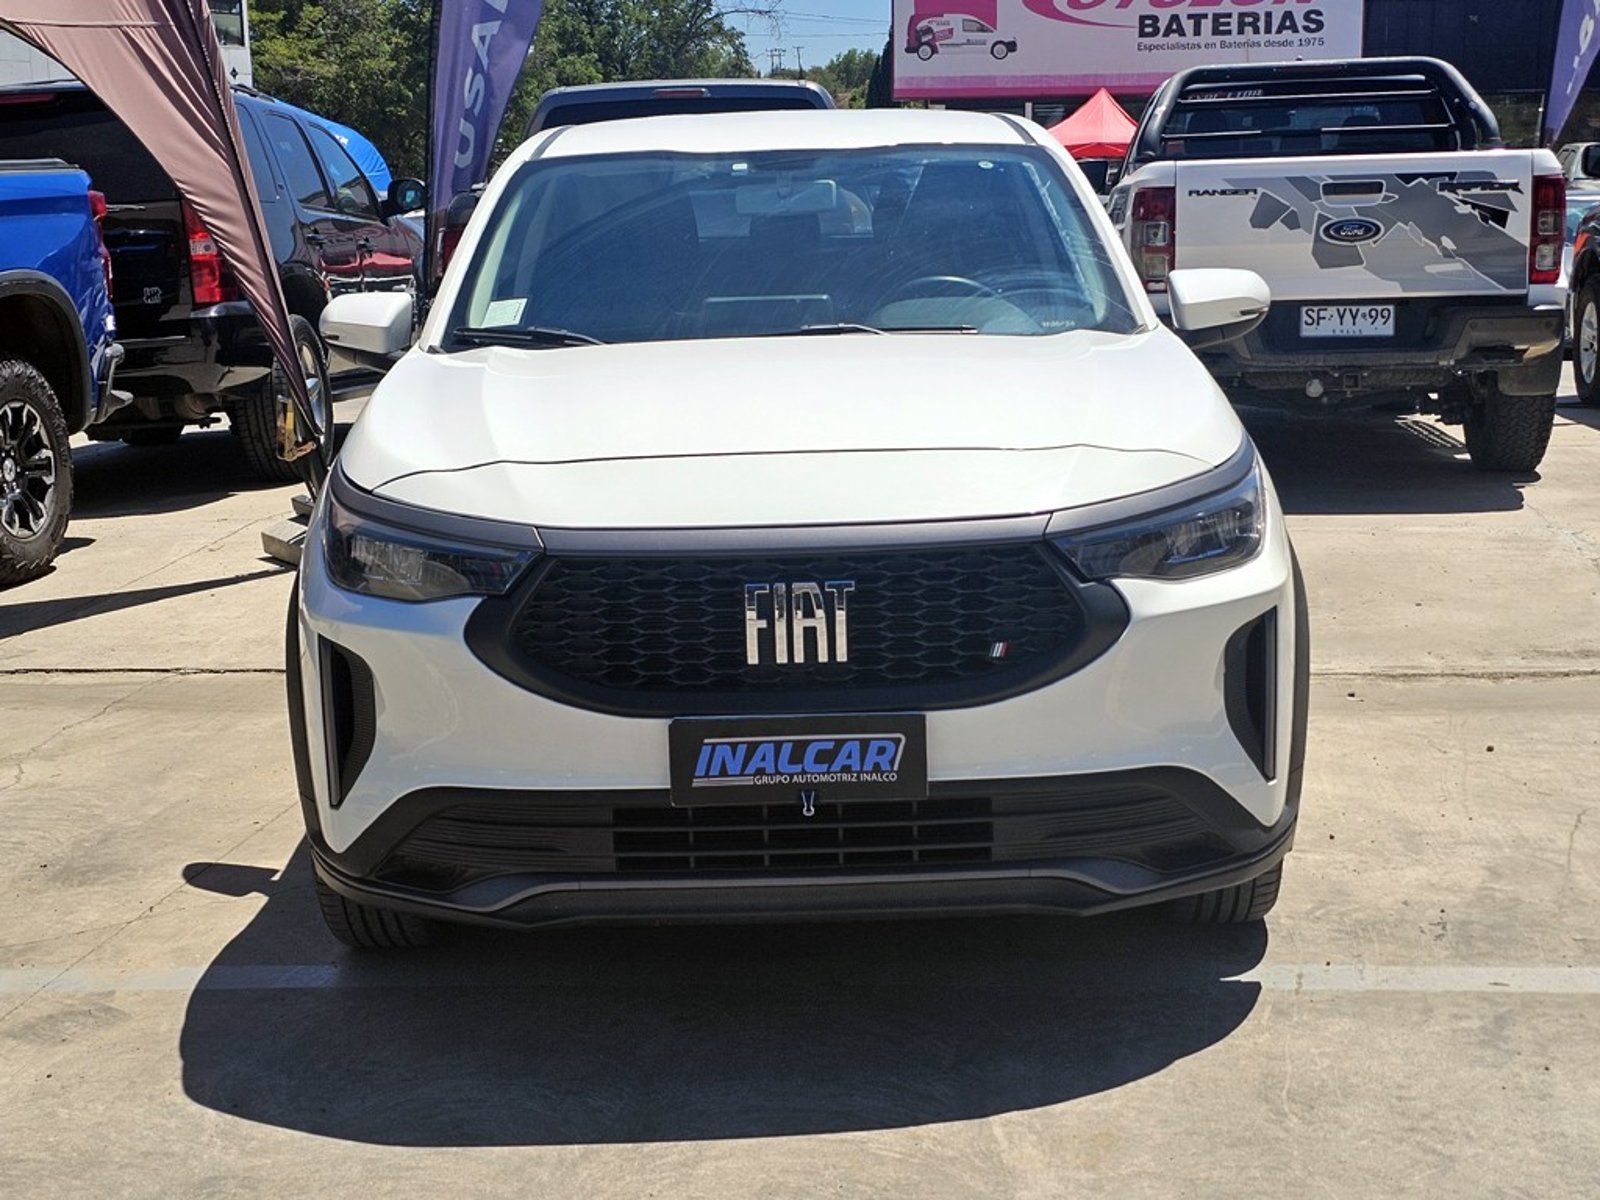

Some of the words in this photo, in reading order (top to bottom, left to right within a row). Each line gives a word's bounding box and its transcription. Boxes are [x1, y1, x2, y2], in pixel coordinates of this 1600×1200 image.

[1138, 9, 1325, 38] BATERIAS
[1137, 41, 1202, 52] Especialistas
[1204, 42, 1216, 50] en
[1264, 39, 1295, 48] desde
[1298, 37, 1325, 47] 1975
[1188, 188, 1258, 197] RANGER
[745, 581, 855, 665] FIAT
[694, 740, 896, 777] INALCAR
[754, 774, 790, 785] GRUPO
[792, 773, 858, 784] AUTOMOTRIZ
[860, 772, 898, 782] INALCO
